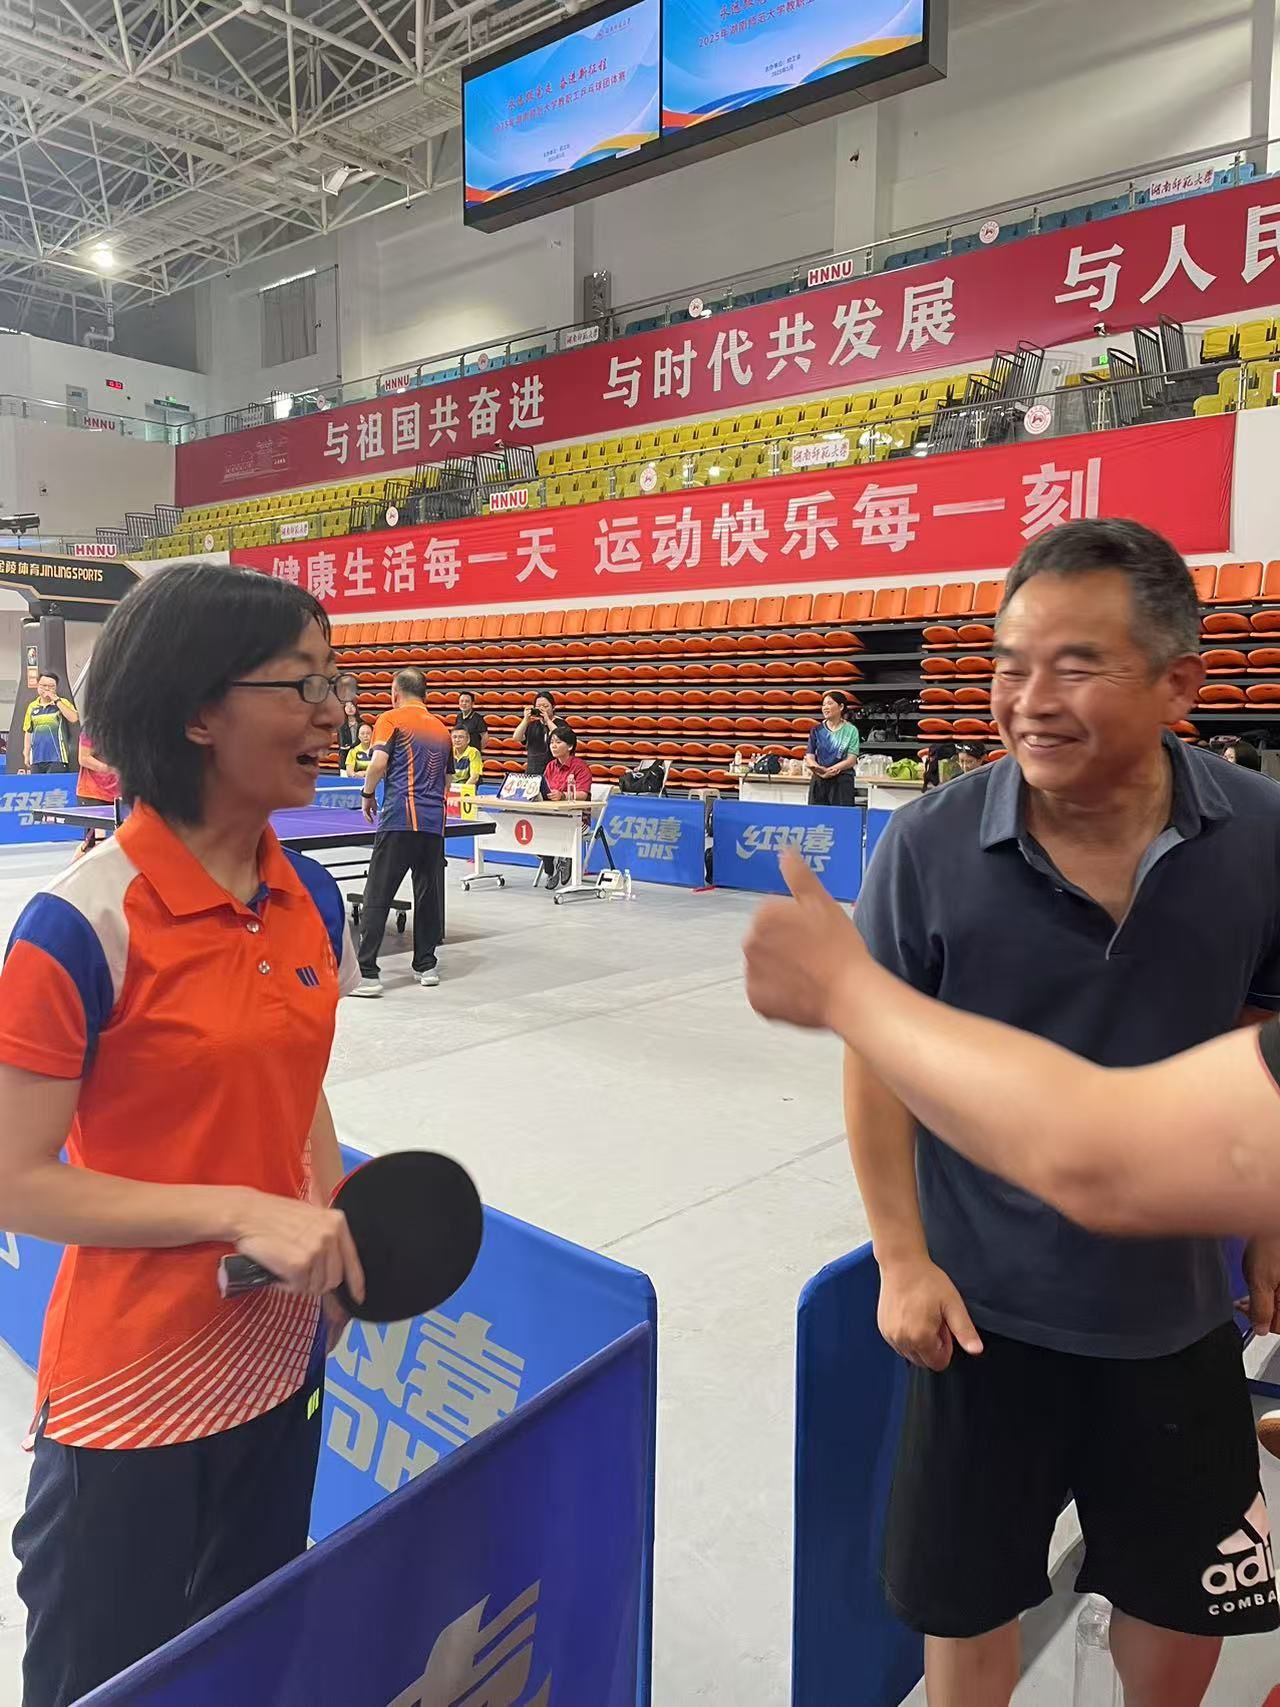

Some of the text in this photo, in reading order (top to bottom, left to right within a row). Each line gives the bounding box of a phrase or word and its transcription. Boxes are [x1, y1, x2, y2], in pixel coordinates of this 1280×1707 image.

[1151, 169, 1213, 196] 湖南师范大学
[810, 261, 852, 284] HNNU
[323, 374, 545, 465] 与祖国共奋进
[602, 276, 957, 408] 与时代共发展
[385, 375, 409, 390] HNNU
[84, 416, 115, 430] HNNU
[491, 490, 527, 509] HNNU
[271, 457, 1102, 600] 健康生活每一天 运动快乐每一刻
[76, 545, 115, 556] HNNU
[521, 825, 529, 840] 1
[604, 815, 682, 846] 红双喜
[636, 842, 679, 860] DHS
[736, 824, 835, 859] 红双喜
